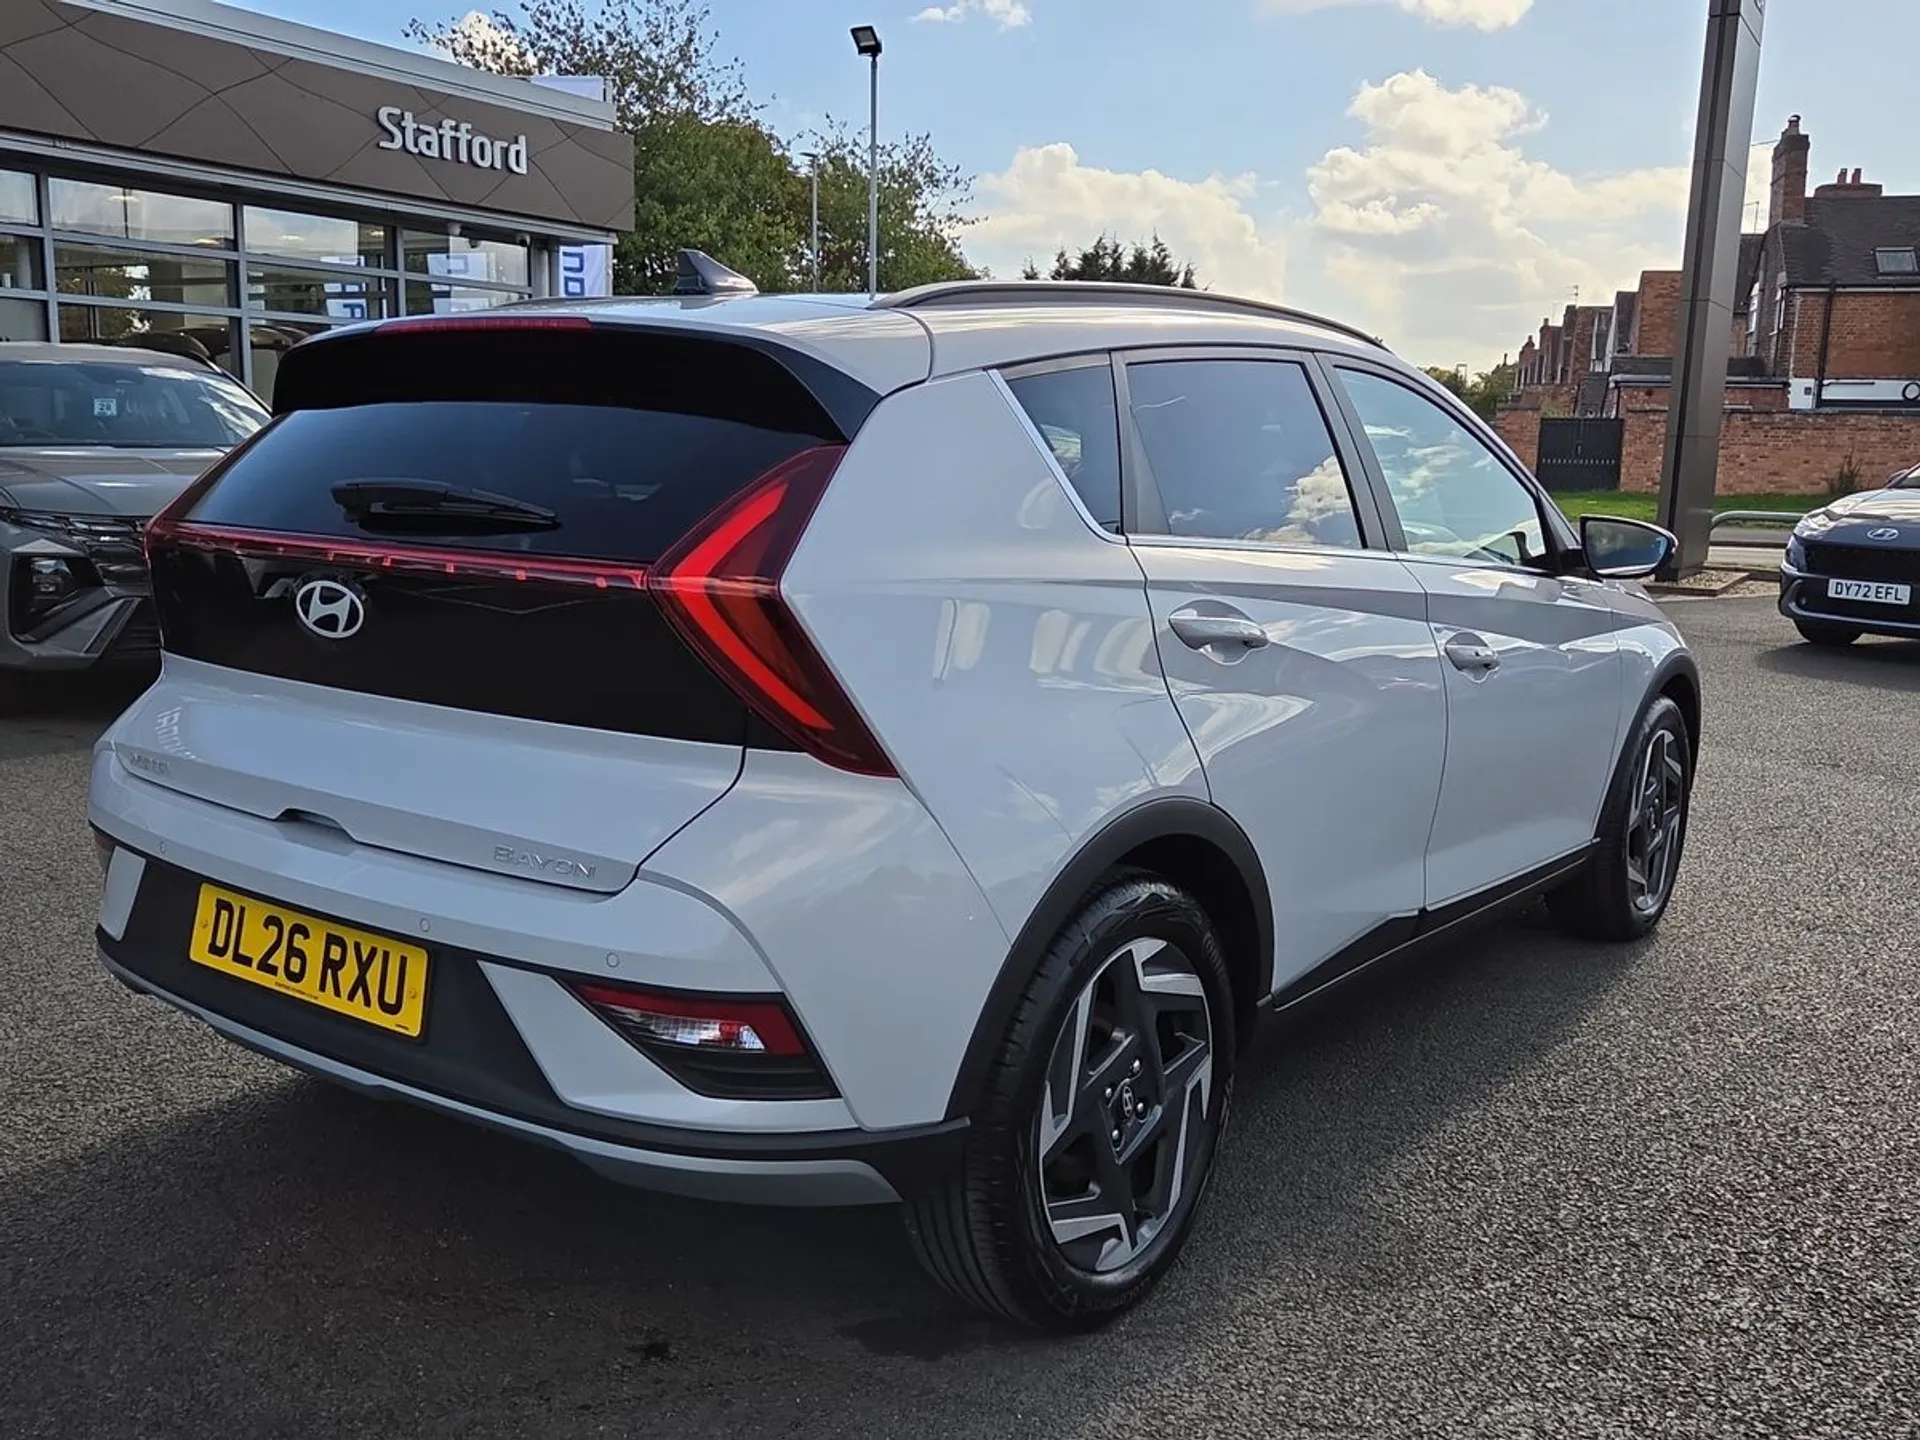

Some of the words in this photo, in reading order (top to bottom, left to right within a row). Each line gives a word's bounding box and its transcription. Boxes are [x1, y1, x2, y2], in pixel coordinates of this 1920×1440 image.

[378, 106, 528, 175] Stafford
[1834, 582, 1872, 599] DY72
[1875, 585, 1904, 602] EFL
[494, 845, 596, 878] BAYON
[207, 897, 311, 984] DL26
[318, 932, 408, 1016] RXU
